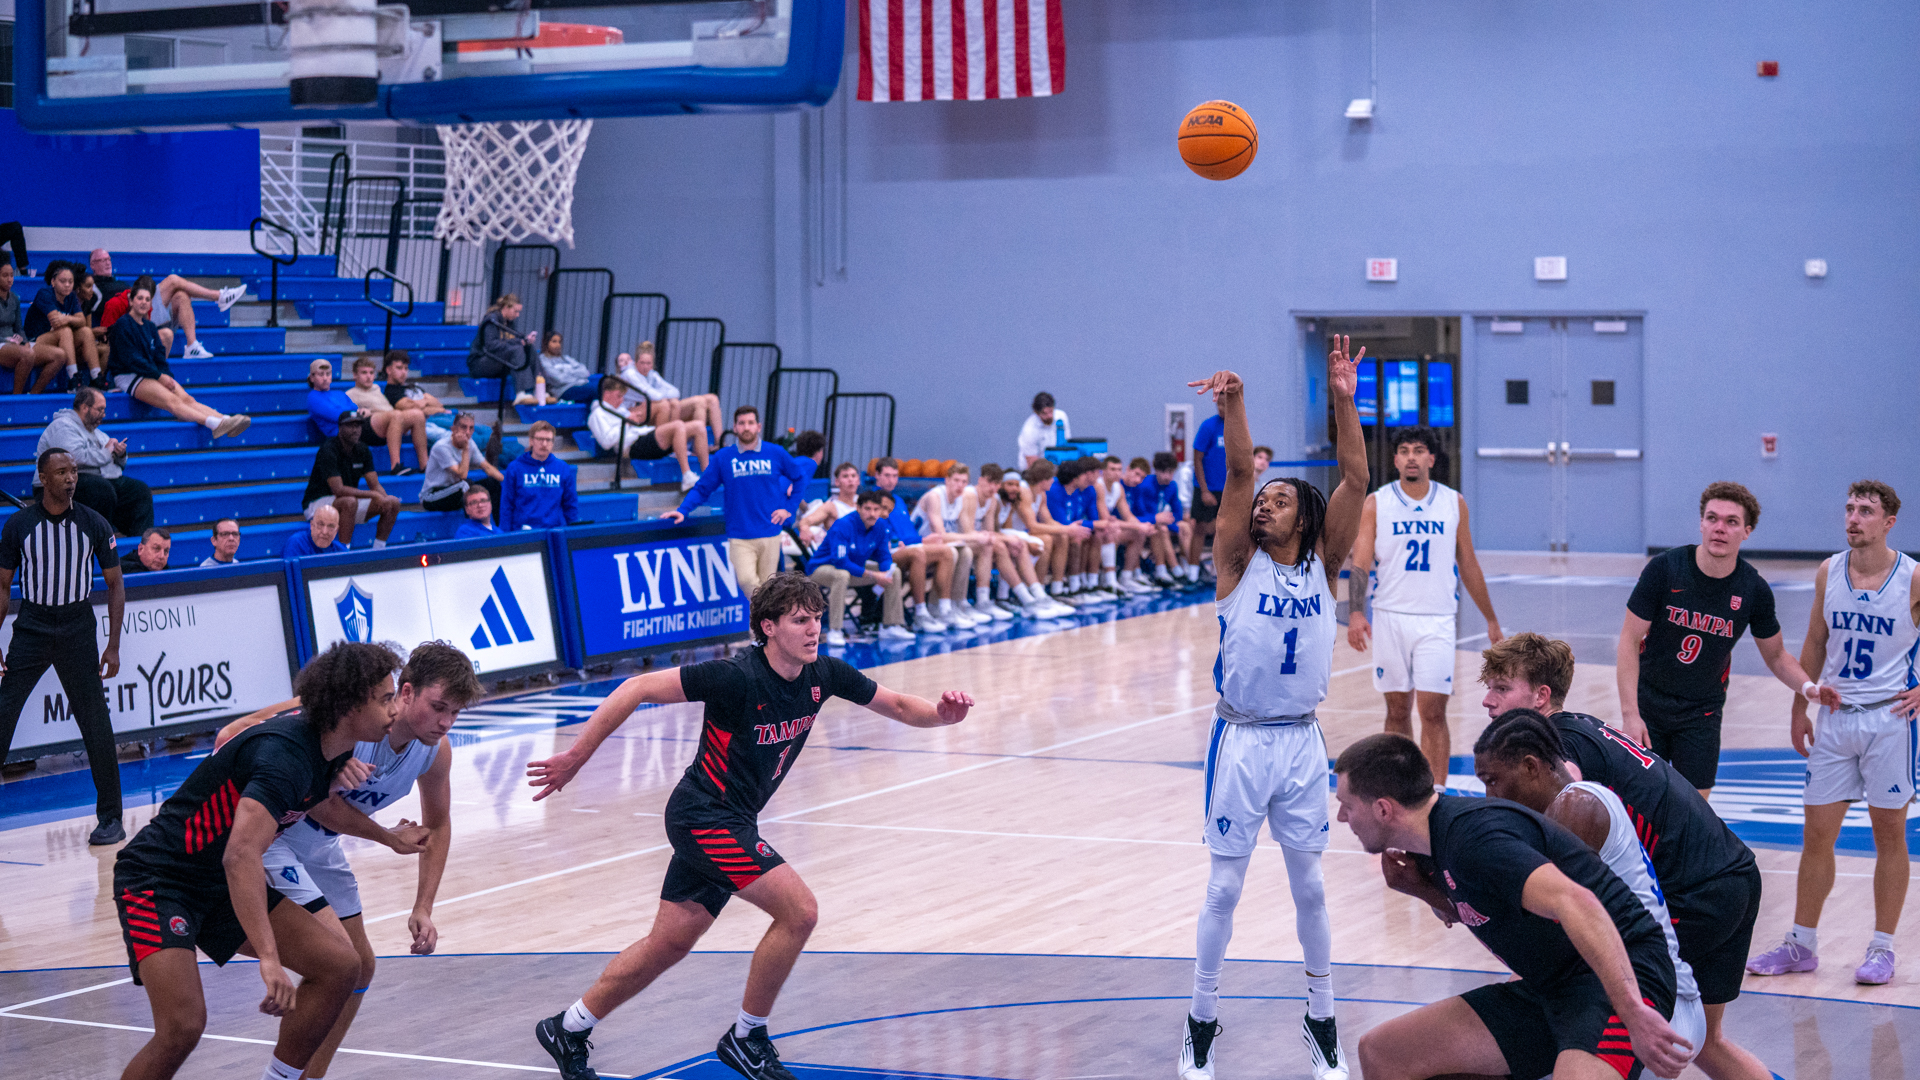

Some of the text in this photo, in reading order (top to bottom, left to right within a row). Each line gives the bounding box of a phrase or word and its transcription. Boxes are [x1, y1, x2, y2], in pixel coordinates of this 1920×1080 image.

[1187, 114, 1223, 127] NCAA
[732, 459, 771, 474] LYNN
[1392, 520, 1444, 536] LYNN
[1405, 539, 1430, 572] 21
[613, 541, 739, 614] LYNN
[102, 605, 196, 637] DVISION II
[1256, 592, 1321, 619] LYNN
[1666, 605, 1733, 638] TAMPA
[623, 604, 744, 640] FIGHTING KNIGHTS
[1832, 611, 1896, 636] LYNN
[1280, 627, 1298, 675] 1
[1676, 634, 1703, 664] 9
[1838, 637, 1875, 680] 15
[117, 682, 138, 712] IT
[771, 745, 791, 780] 1
